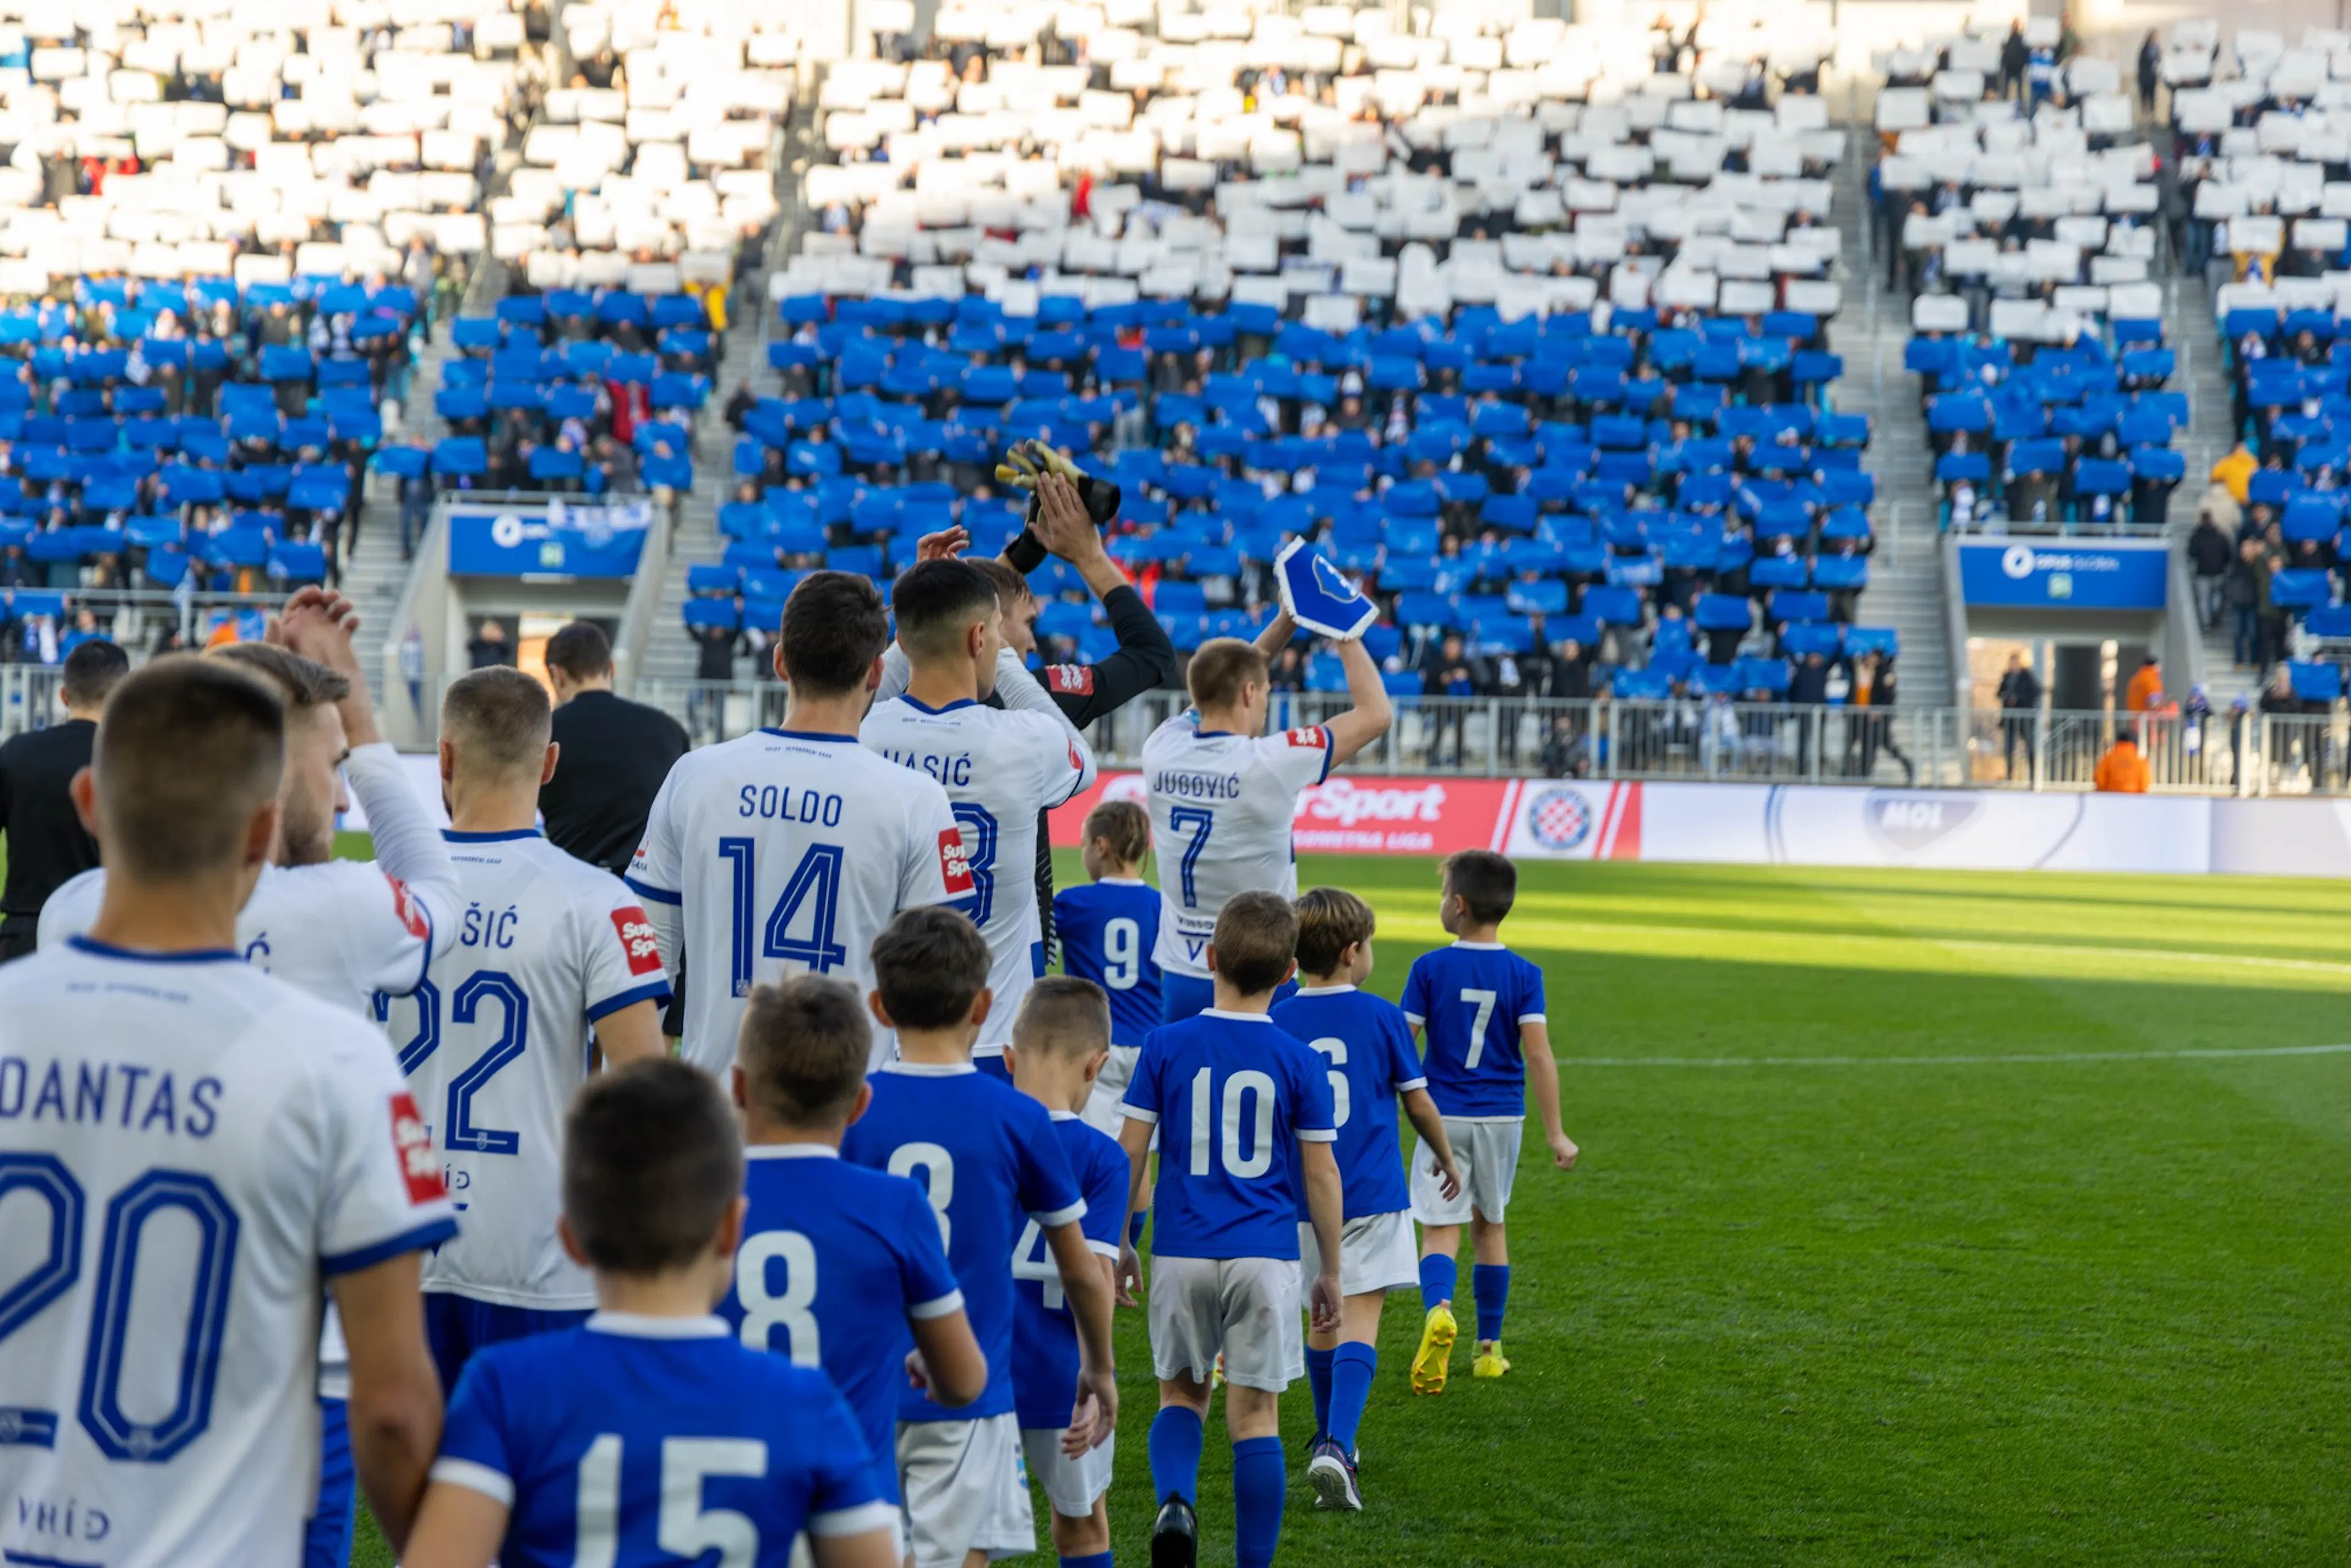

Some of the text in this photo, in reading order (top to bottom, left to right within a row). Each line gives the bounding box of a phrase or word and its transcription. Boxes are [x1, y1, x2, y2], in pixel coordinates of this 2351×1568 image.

[739, 784, 843, 828] SOLDO
[1153, 771, 1240, 799] JUGOVIĆ
[1171, 806, 1213, 908] 7
[719, 836, 846, 997] 14
[1104, 917, 1139, 990] 9
[372, 969, 529, 1155] 22
[1460, 987, 1497, 1070] 7
[0, 1056, 223, 1139] DANTAS
[1190, 1067, 1276, 1179] 10
[0, 1149, 241, 1464] 20
[737, 1229, 821, 1371] 8
[1011, 1217, 1064, 1310] 4
[572, 1431, 769, 1568] 15
